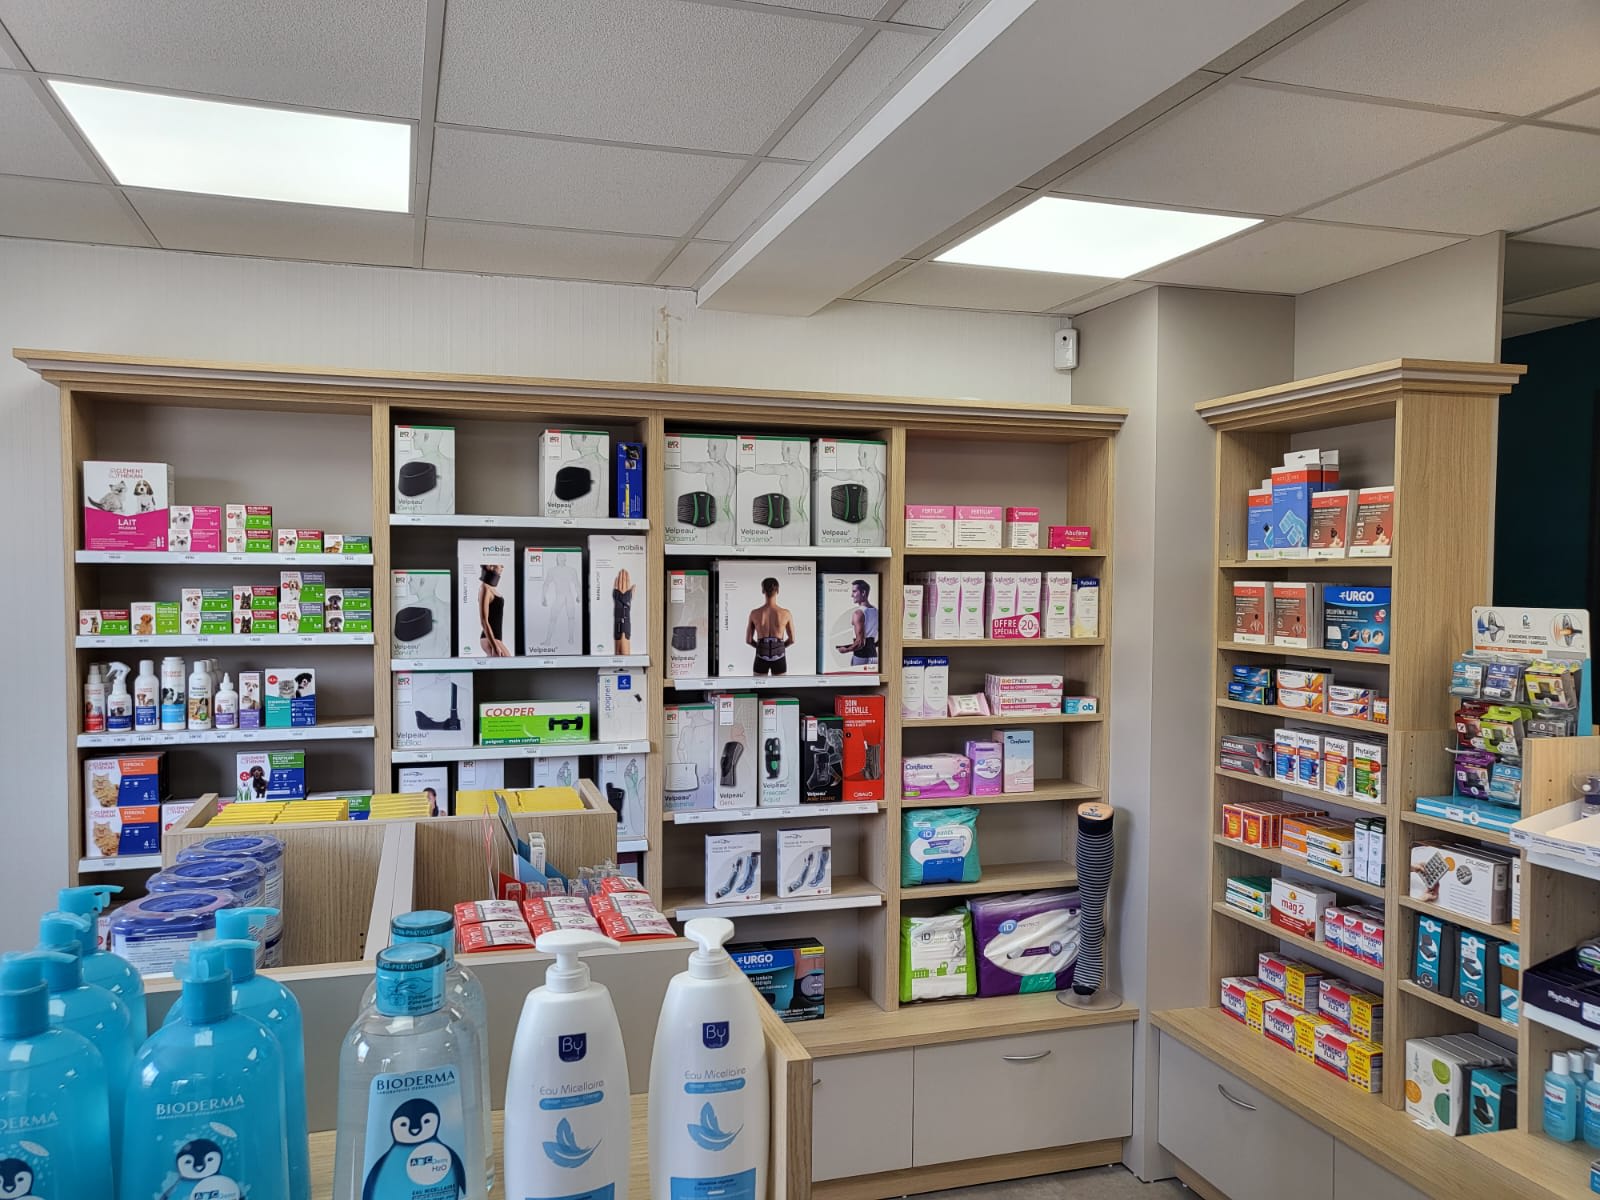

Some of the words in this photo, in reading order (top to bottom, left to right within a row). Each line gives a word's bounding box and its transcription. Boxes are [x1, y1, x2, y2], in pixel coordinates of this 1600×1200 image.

[665, 527, 694, 536] Velpeau
[741, 528, 769, 536] Velpeau
[822, 529, 849, 537] Velpeau
[1346, 591, 1375, 602] URGO
[994, 619, 1017, 628] OFFRE
[485, 707, 535, 717] COOPER
[1281, 899, 1297, 915] mag
[1298, 905, 1305, 915] 2
[1003, 923, 1014, 932] iD
[743, 953, 774, 965] URGO
[706, 1024, 727, 1043] By
[562, 1036, 584, 1056] By
[684, 1070, 702, 1080] Eau
[704, 1066, 747, 1079] Micellaire
[376, 1069, 456, 1091] BIODERMA
[539, 1086, 558, 1096] Eau
[560, 1079, 605, 1095] Micellaire
[155, 1094, 245, 1116] BIODERMA
